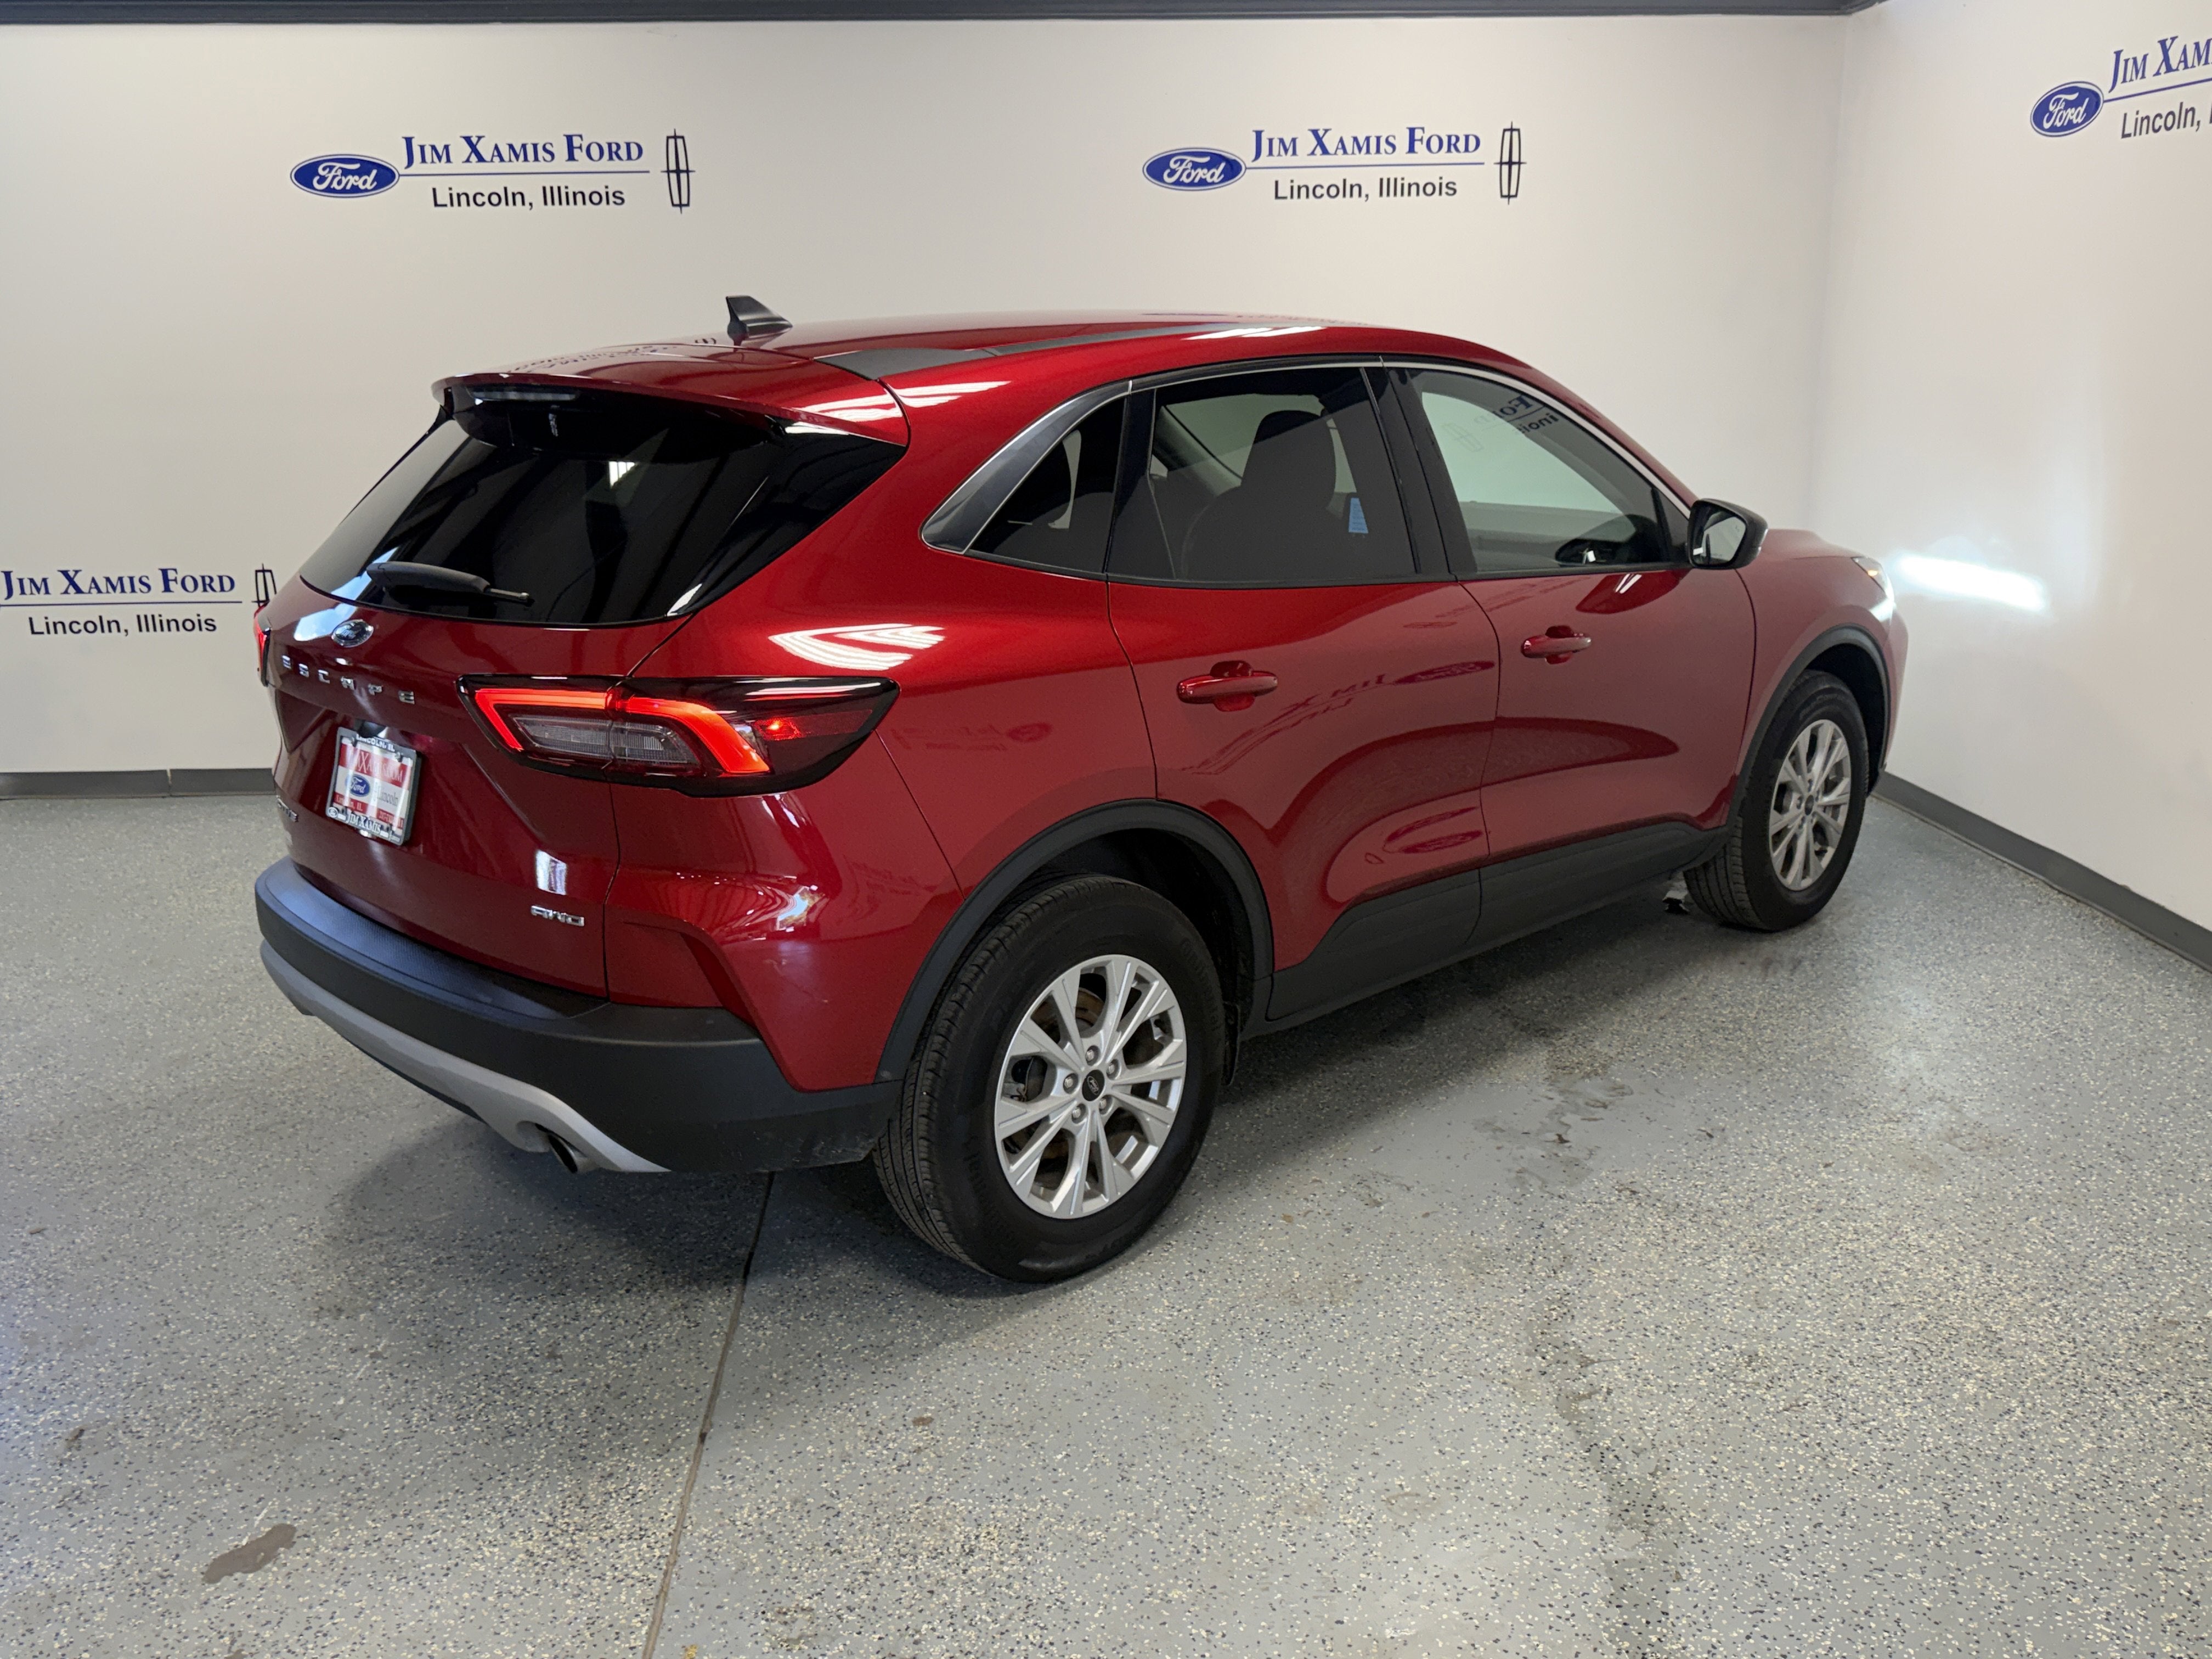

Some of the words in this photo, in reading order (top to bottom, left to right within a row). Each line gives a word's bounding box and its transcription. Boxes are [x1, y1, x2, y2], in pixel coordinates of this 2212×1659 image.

[2108, 49, 2149, 93] JIM
[2153, 35, 2212, 77] XAM
[2042, 92, 2090, 129] Ford
[2121, 101, 2200, 138] Lincoln,
[402, 136, 452, 169] JIM
[460, 135, 555, 163] XAMIS
[563, 134, 643, 162] FORD
[1251, 129, 1298, 163] JIM
[1307, 128, 1397, 156] XAMIS
[1406, 127, 1481, 154] FORD
[312, 162, 377, 191] Ford
[1163, 155, 1225, 184] Ford
[432, 186, 533, 210] Lincoln,
[542, 185, 625, 206] Illinois
[1274, 178, 1369, 202] Lincoln,
[1379, 176, 1457, 198] Illinois
[1, 571, 52, 601] JIM
[57, 568, 152, 595] XAMIS
[158, 568, 235, 593] FORD
[28, 615, 128, 636] Lincoln,
[136, 613, 217, 633] Illinois
[281, 654, 415, 704] ESCAPE
